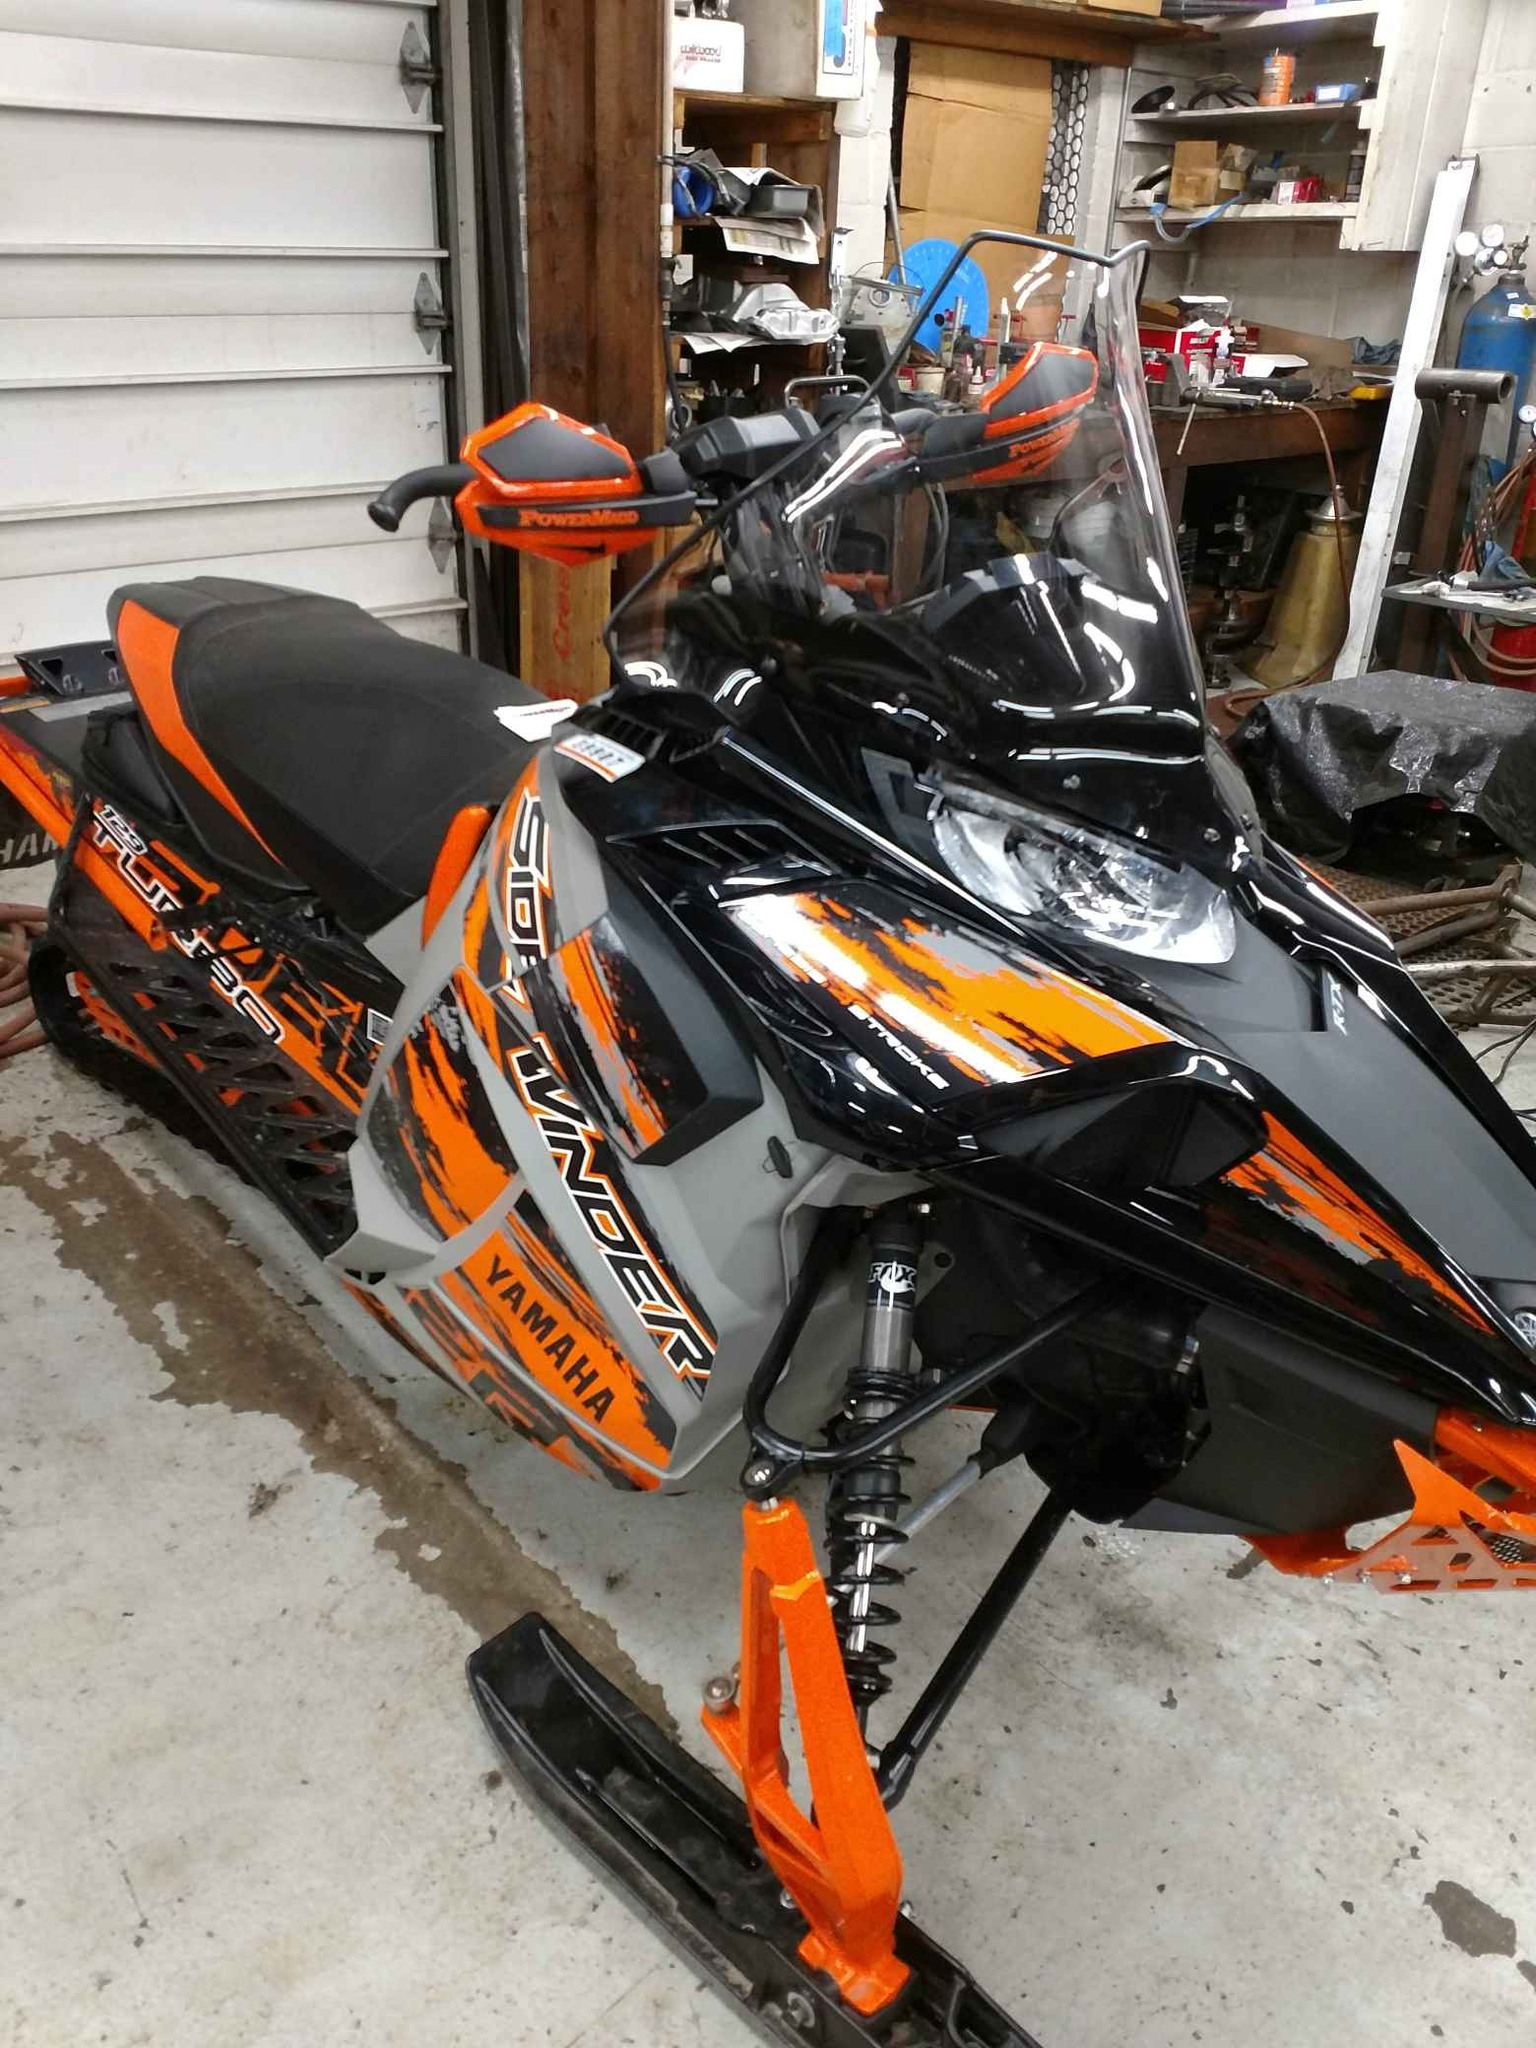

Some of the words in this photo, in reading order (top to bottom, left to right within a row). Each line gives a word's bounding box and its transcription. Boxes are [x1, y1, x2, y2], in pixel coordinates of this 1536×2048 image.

[101, 804, 148, 855] 129
[847, 1003, 951, 1090] STROKE
[868, 1261, 917, 1290] FOX
[486, 1254, 616, 1424] YAMAHA
